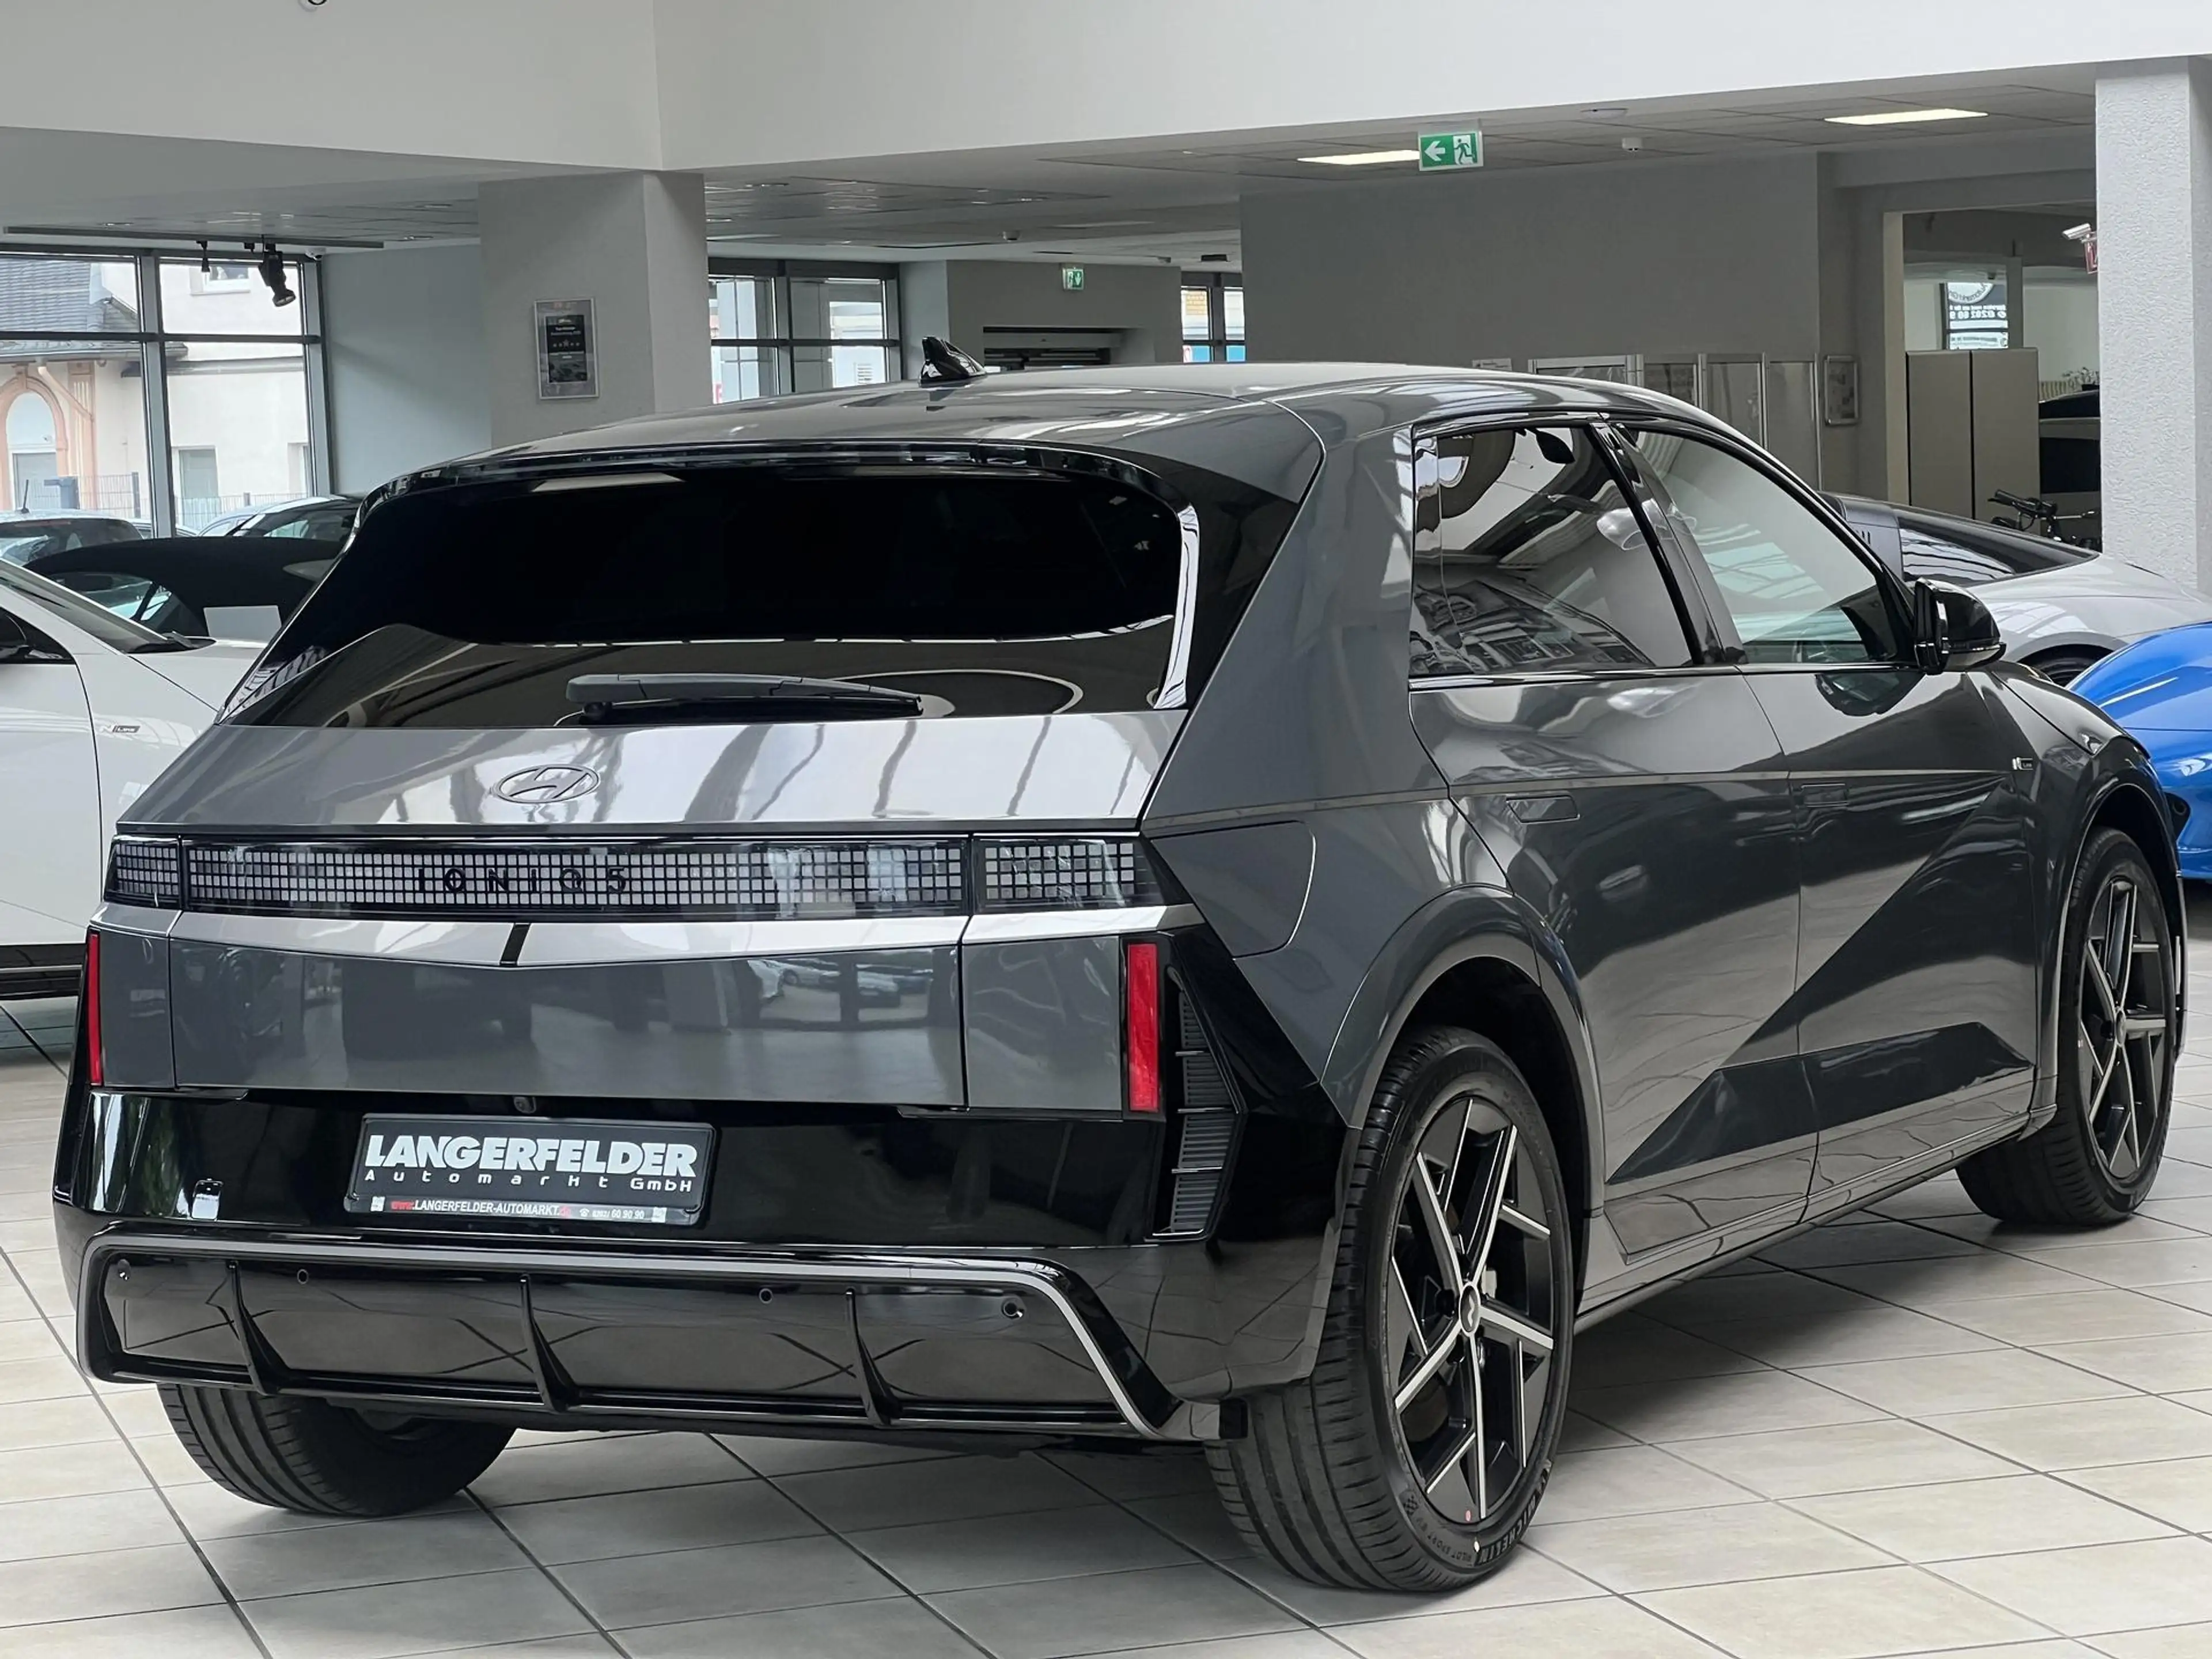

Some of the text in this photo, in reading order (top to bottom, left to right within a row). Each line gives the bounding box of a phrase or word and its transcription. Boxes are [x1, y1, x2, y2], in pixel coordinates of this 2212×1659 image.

[416, 866, 627, 893] IONIQ 5
[365, 1134, 698, 1178] LANGERFELDER
[630, 1176, 693, 1193] GmbH
[1479, 1495, 1537, 1563] MICHELIN
